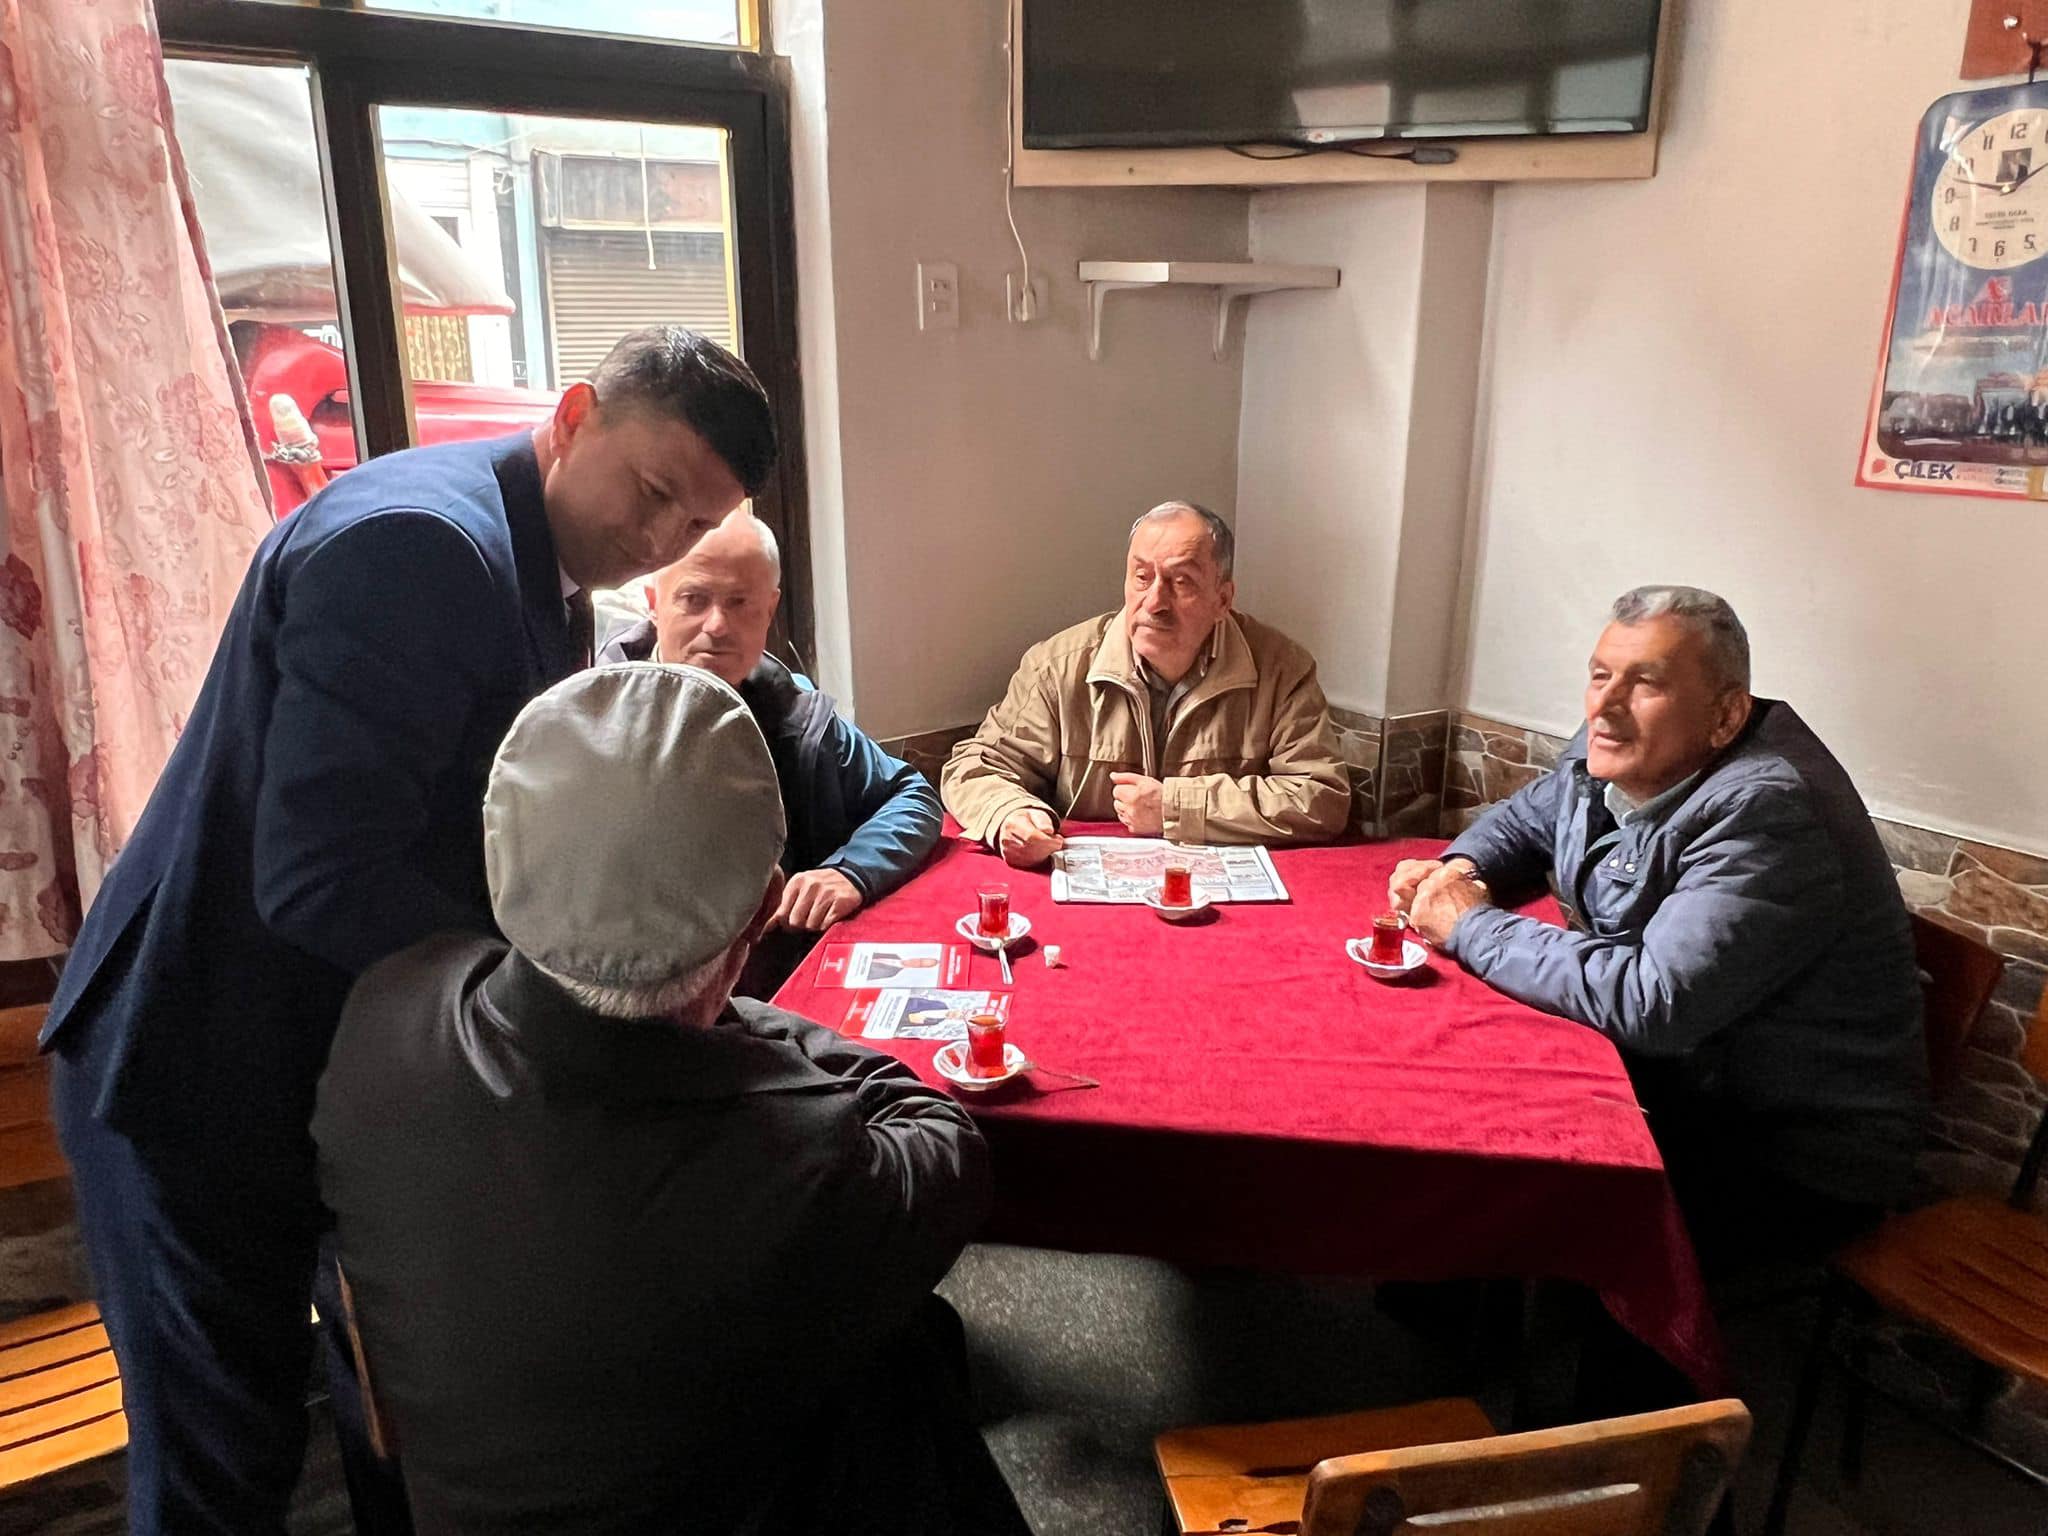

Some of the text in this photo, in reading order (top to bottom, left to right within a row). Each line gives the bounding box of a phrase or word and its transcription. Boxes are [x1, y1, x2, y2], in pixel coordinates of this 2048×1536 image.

[2011, 123, 2027, 139] 12
[1983, 135, 1994, 150] 11
[1994, 240, 2006, 256] 6
